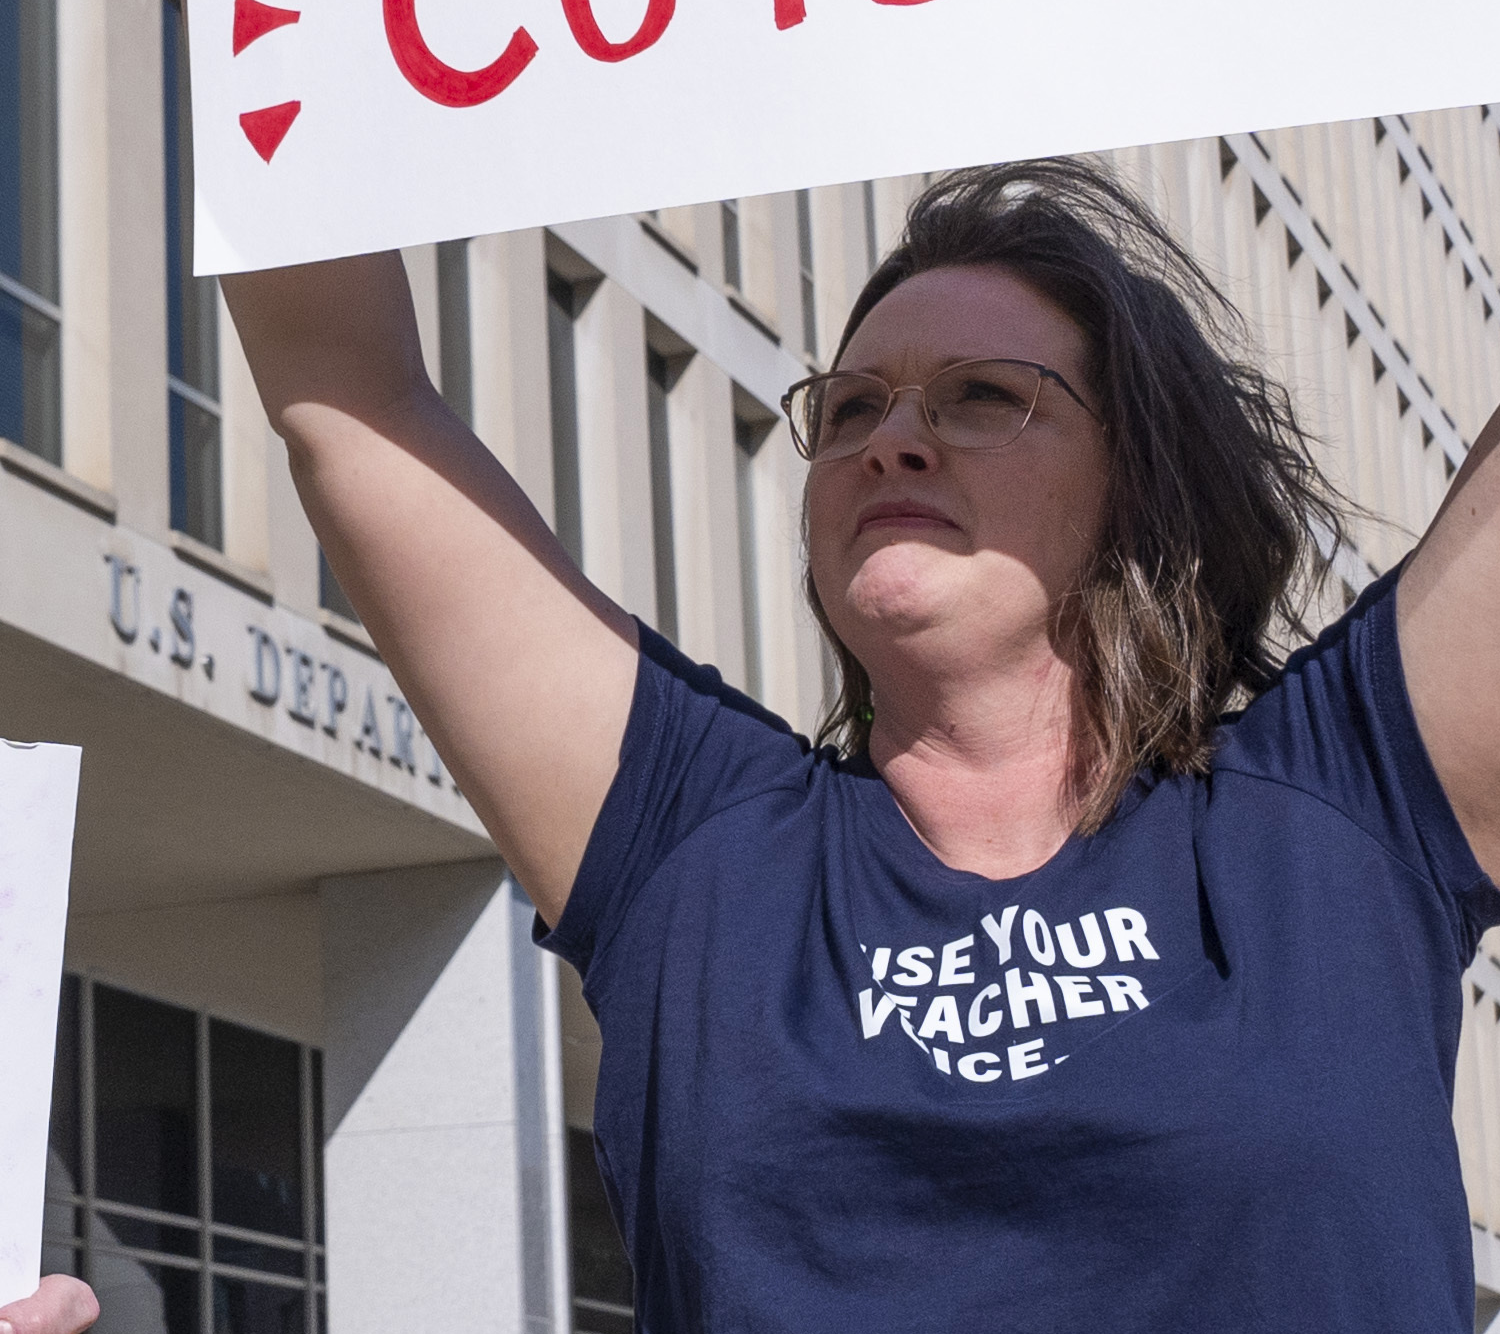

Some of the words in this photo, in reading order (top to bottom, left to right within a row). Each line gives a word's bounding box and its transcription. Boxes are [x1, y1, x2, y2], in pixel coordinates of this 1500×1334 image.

[103, 552, 214, 681] U.S.
[245, 624, 462, 798] DEPAR
[980, 904, 1161, 969] YOUR
